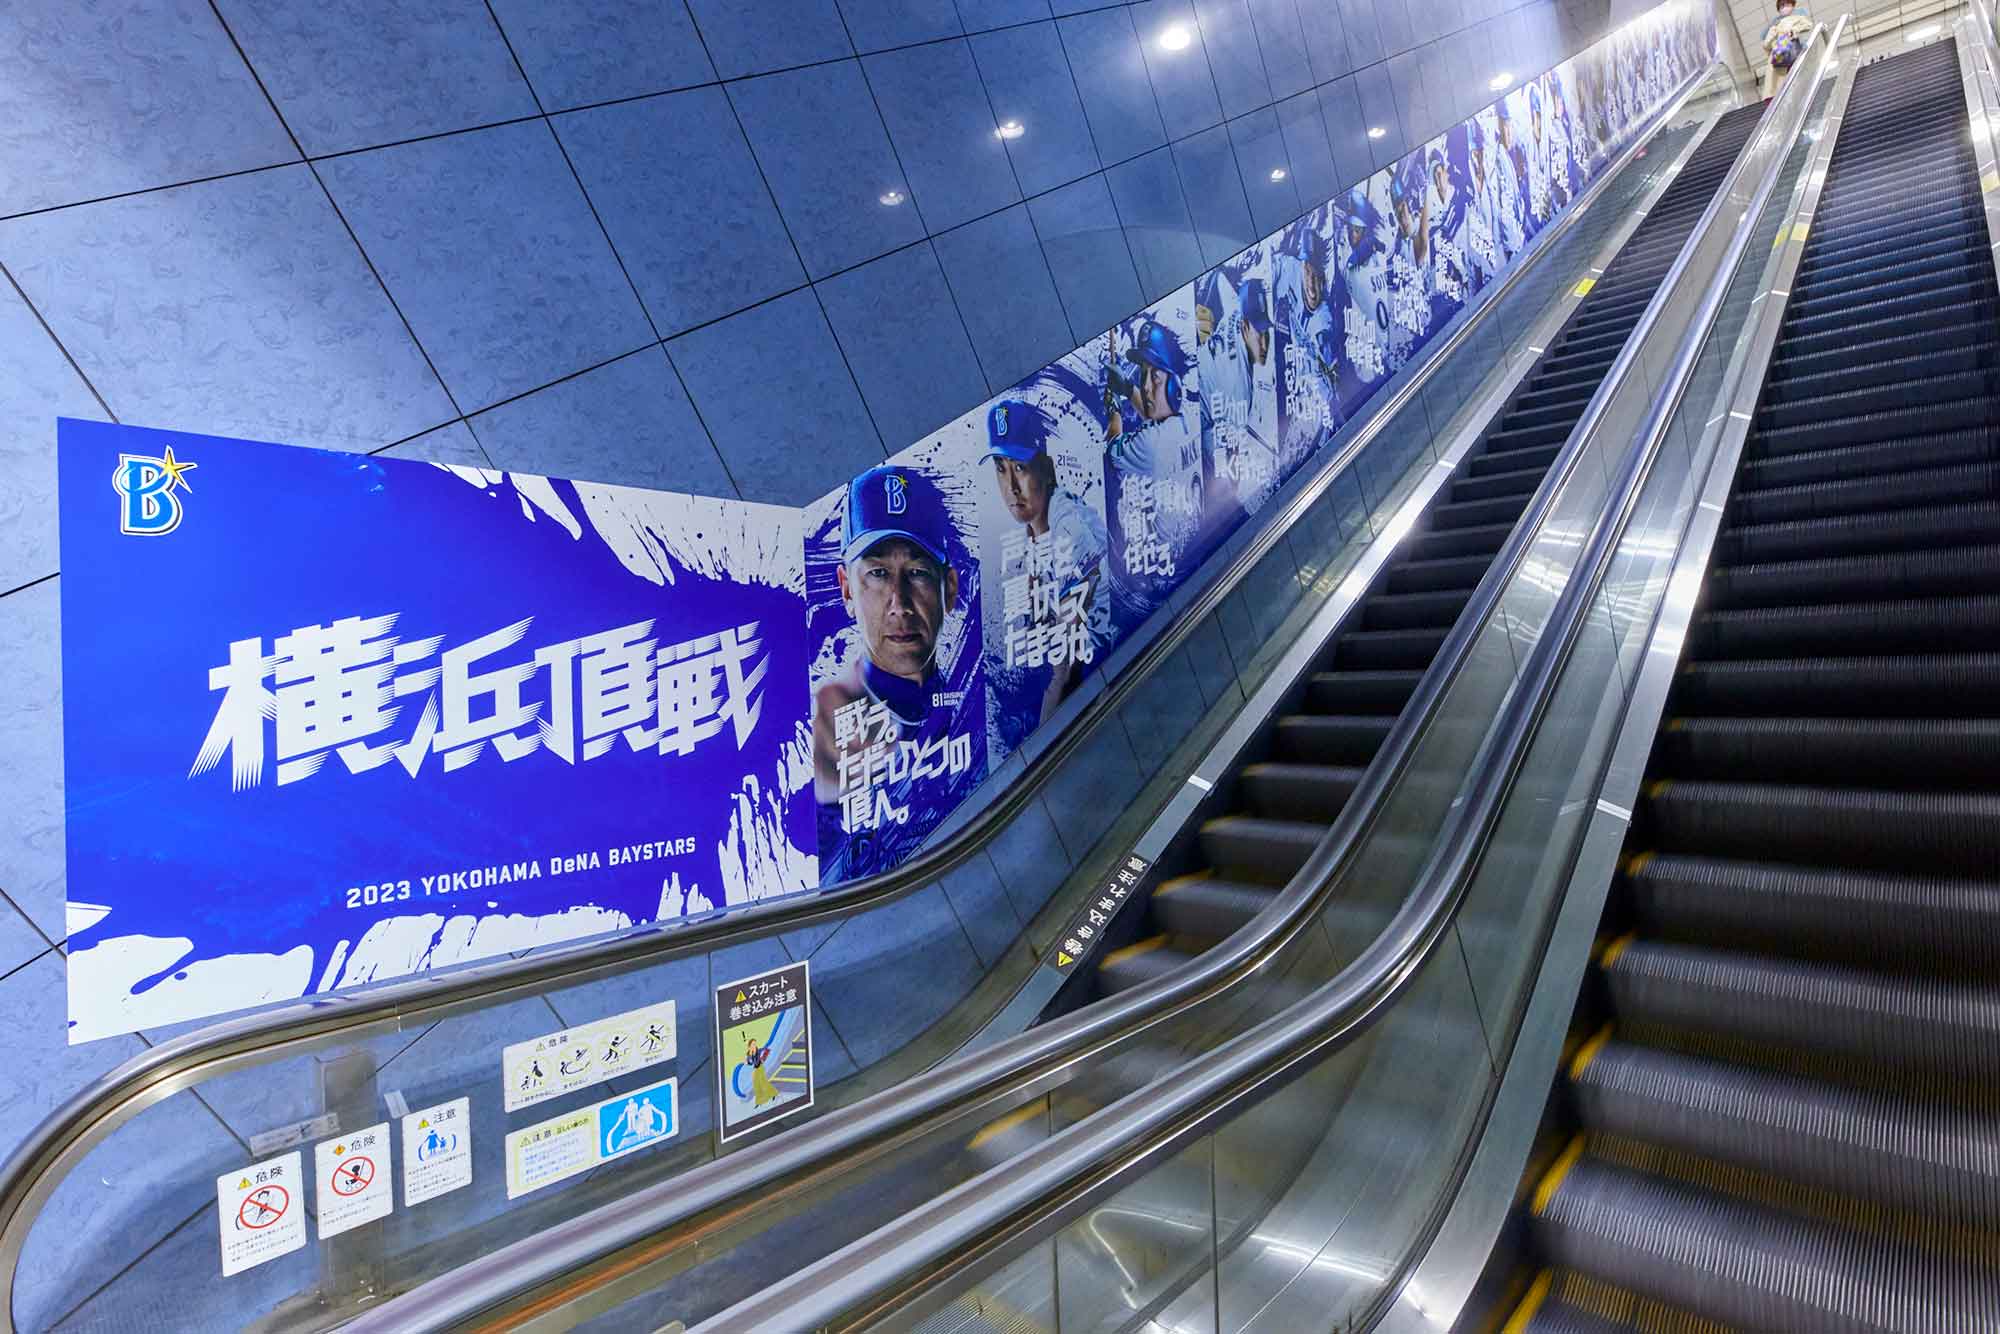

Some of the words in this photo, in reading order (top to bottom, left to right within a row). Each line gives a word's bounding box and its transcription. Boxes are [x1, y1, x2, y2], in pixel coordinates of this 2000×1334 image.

[188, 612, 770, 793] 横浜頂戦
[932, 693, 944, 708] 81
[836, 732, 971, 792] ただひとつの
[346, 880, 412, 909] 2023
[420, 860, 542, 897] YOKOHAMA
[550, 851, 601, 877] DeNA
[608, 836, 696, 867] BAYSTARS
[748, 975, 789, 999] スカート
[729, 988, 798, 1021] 巻き込み注意
[433, 1108, 456, 1124] 注意
[350, 1135, 376, 1152] 危険
[255, 1166, 283, 1184] 危険
